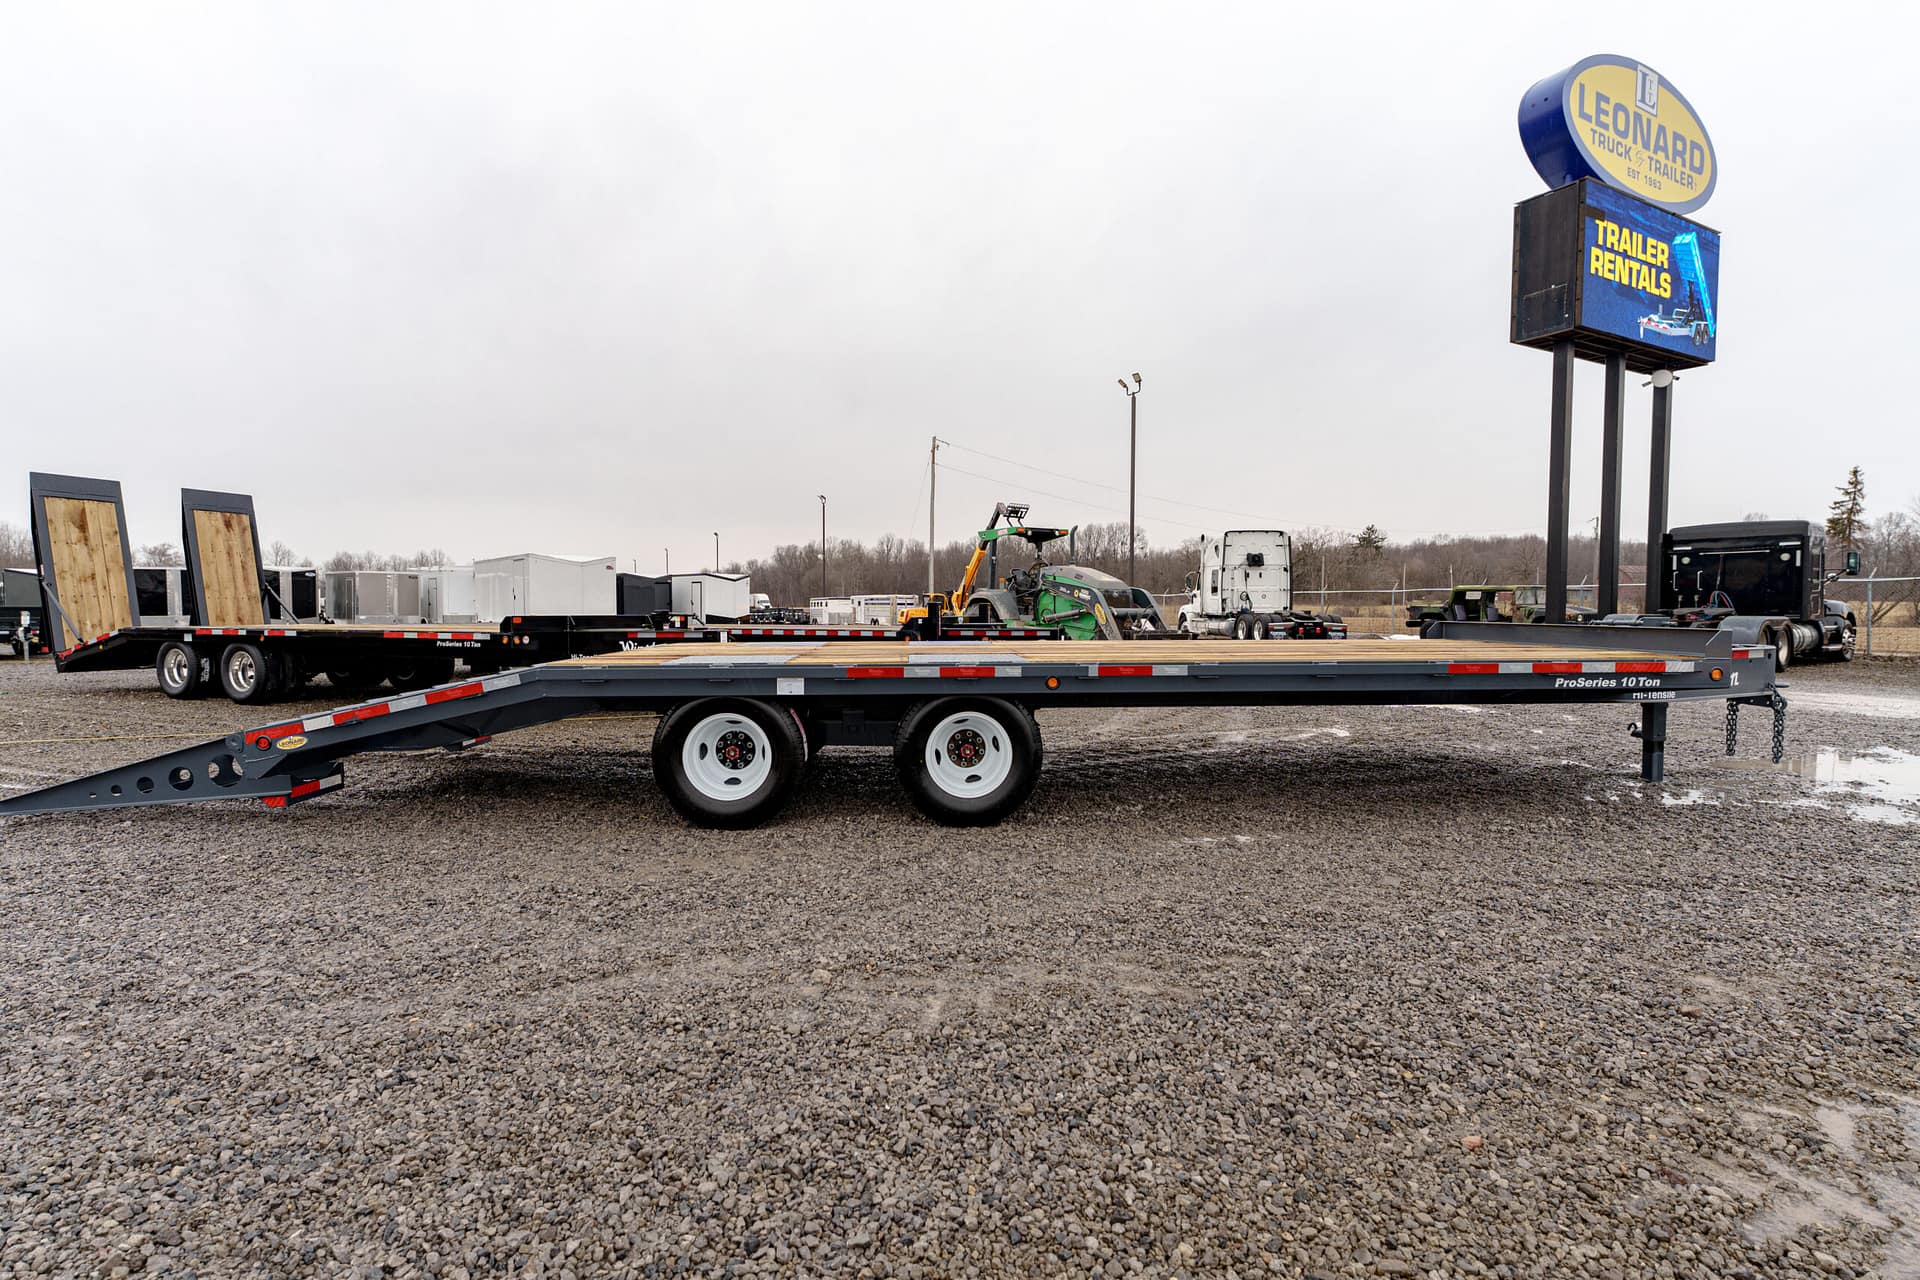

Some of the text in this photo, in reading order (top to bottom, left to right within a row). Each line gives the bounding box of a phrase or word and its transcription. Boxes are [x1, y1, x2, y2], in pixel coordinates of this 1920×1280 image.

[1578, 82, 1705, 176] LEONARD
[1590, 128, 1632, 162] TRUCK
[1648, 155, 1694, 190] TRAILER
[1627, 167, 1640, 181] EST
[1595, 219, 1669, 269] TRAILER
[1590, 246, 1672, 299] RENTALS
[1555, 677, 1660, 688] ProSeries 10 Ton
